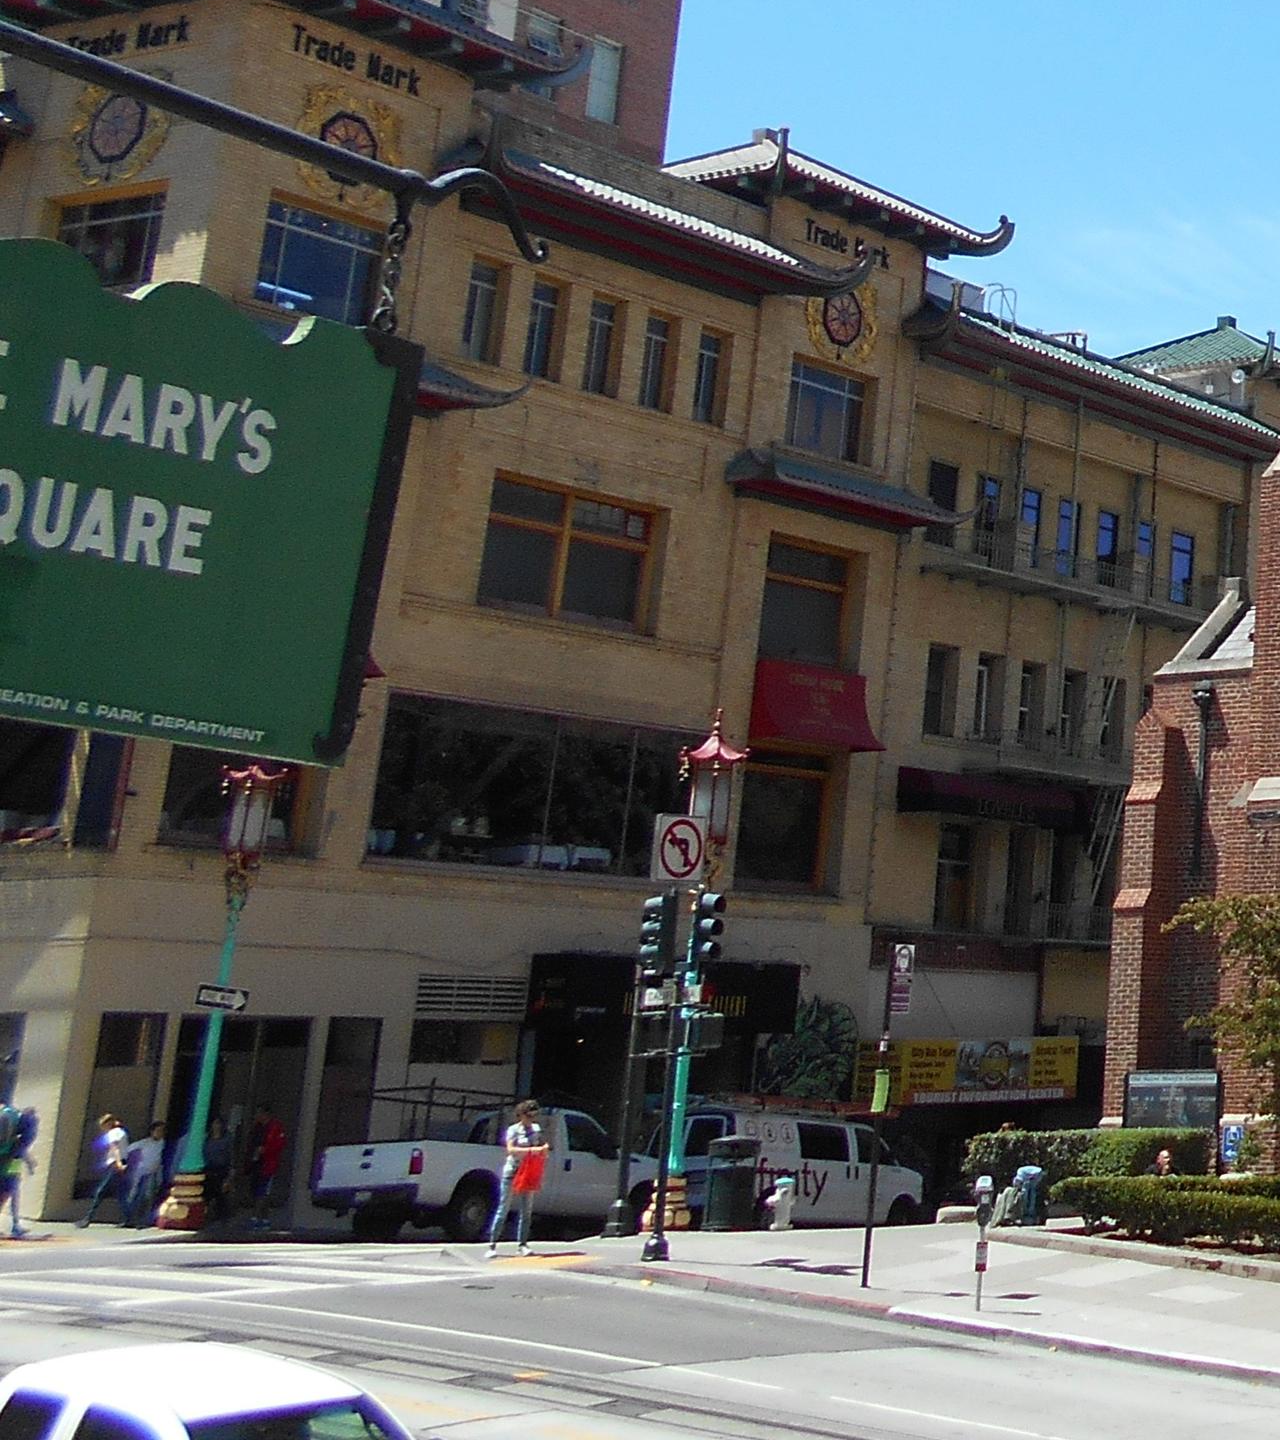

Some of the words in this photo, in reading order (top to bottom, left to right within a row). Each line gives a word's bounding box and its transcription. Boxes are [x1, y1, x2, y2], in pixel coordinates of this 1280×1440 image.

[135, 14, 190, 51] Mark
[293, 22, 356, 72] Trade
[365, 51, 422, 97] Mark
[805, 217, 849, 254] Trade
[854, 235, 891, 270] Mrk
[53, 357, 277, 474] MARY'S
[74, 700, 90, 715] &
[95, 704, 145, 725] PARK
[151, 713, 266, 743] DEPARTMENT
[913, 1090, 958, 1104] TOURIST
[959, 1088, 1026, 1103] INFORMATION
[1028, 1086, 1065, 1101] CENTER
